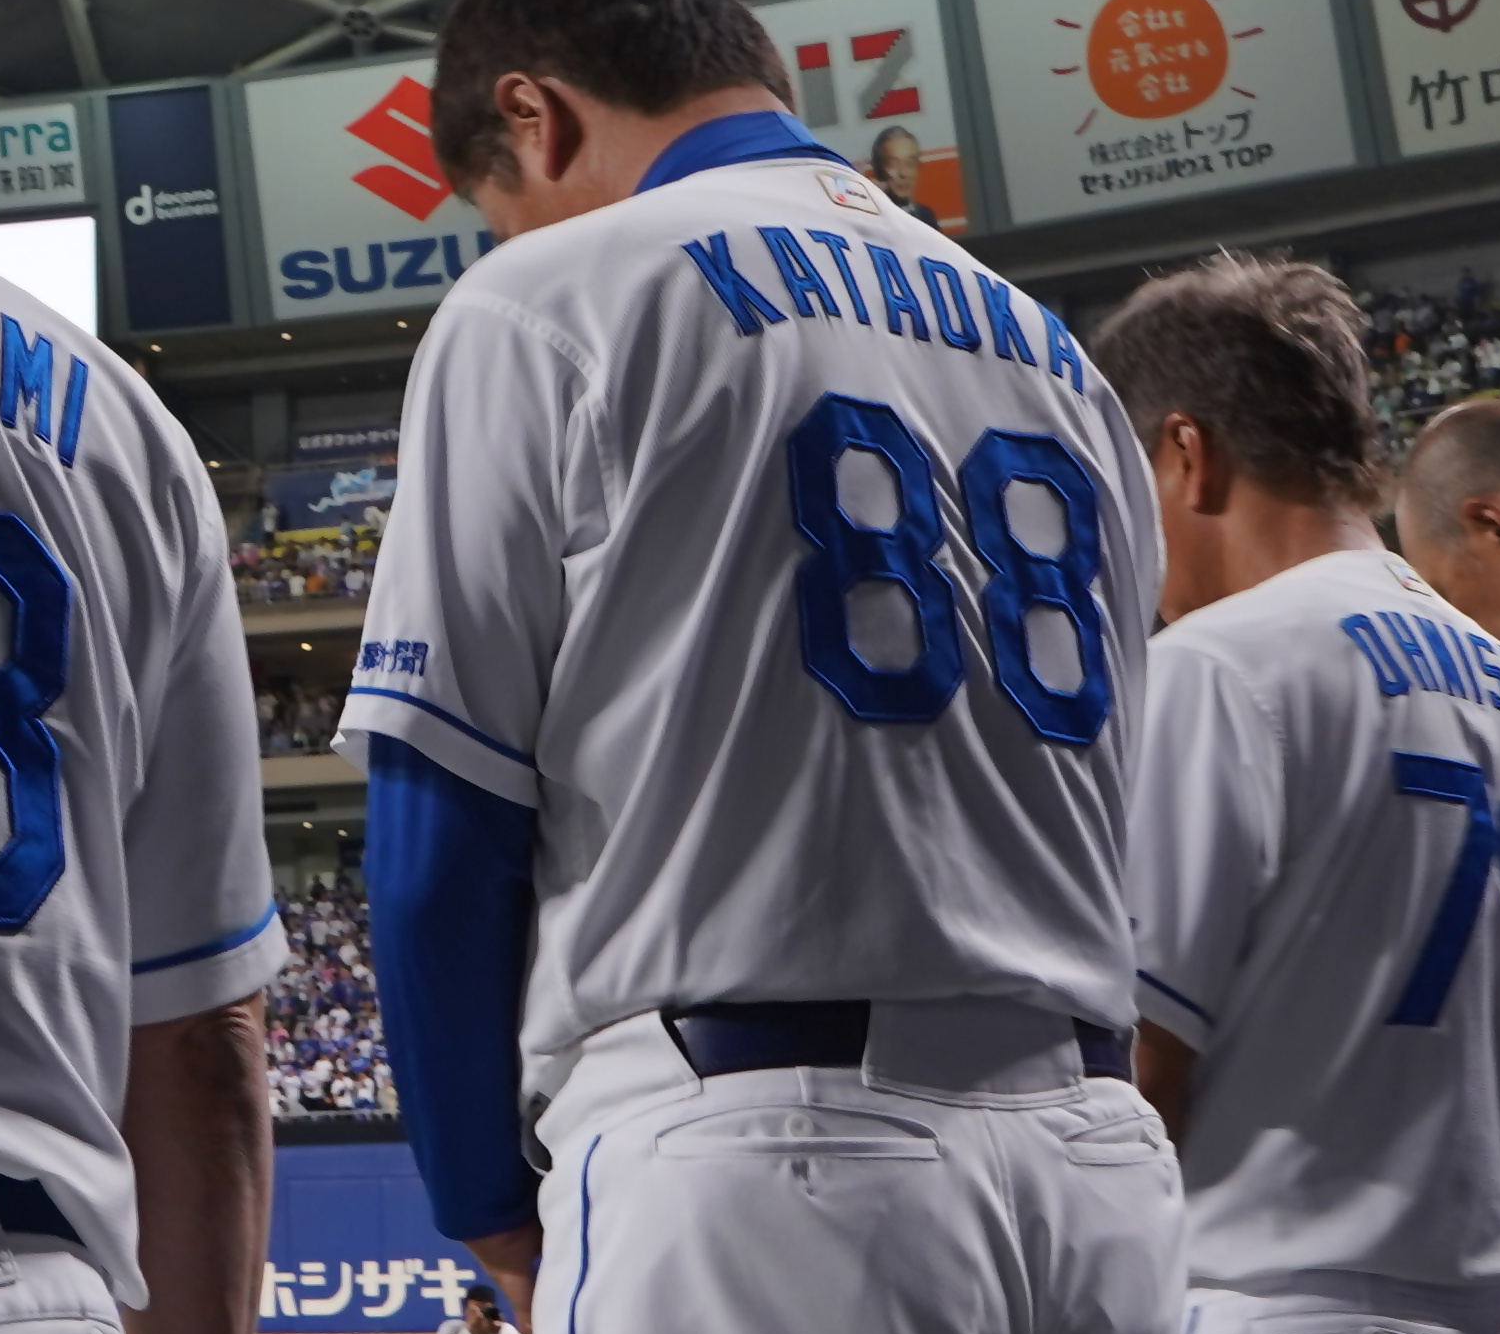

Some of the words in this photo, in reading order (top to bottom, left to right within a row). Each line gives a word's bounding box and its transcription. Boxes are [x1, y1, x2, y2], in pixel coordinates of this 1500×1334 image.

[1219, 143, 1273, 168] TOP
[681, 225, 1084, 396] KATAOKA
[786, 390, 1111, 747] 88
[259, 1259, 476, 1317] ホシザキ
